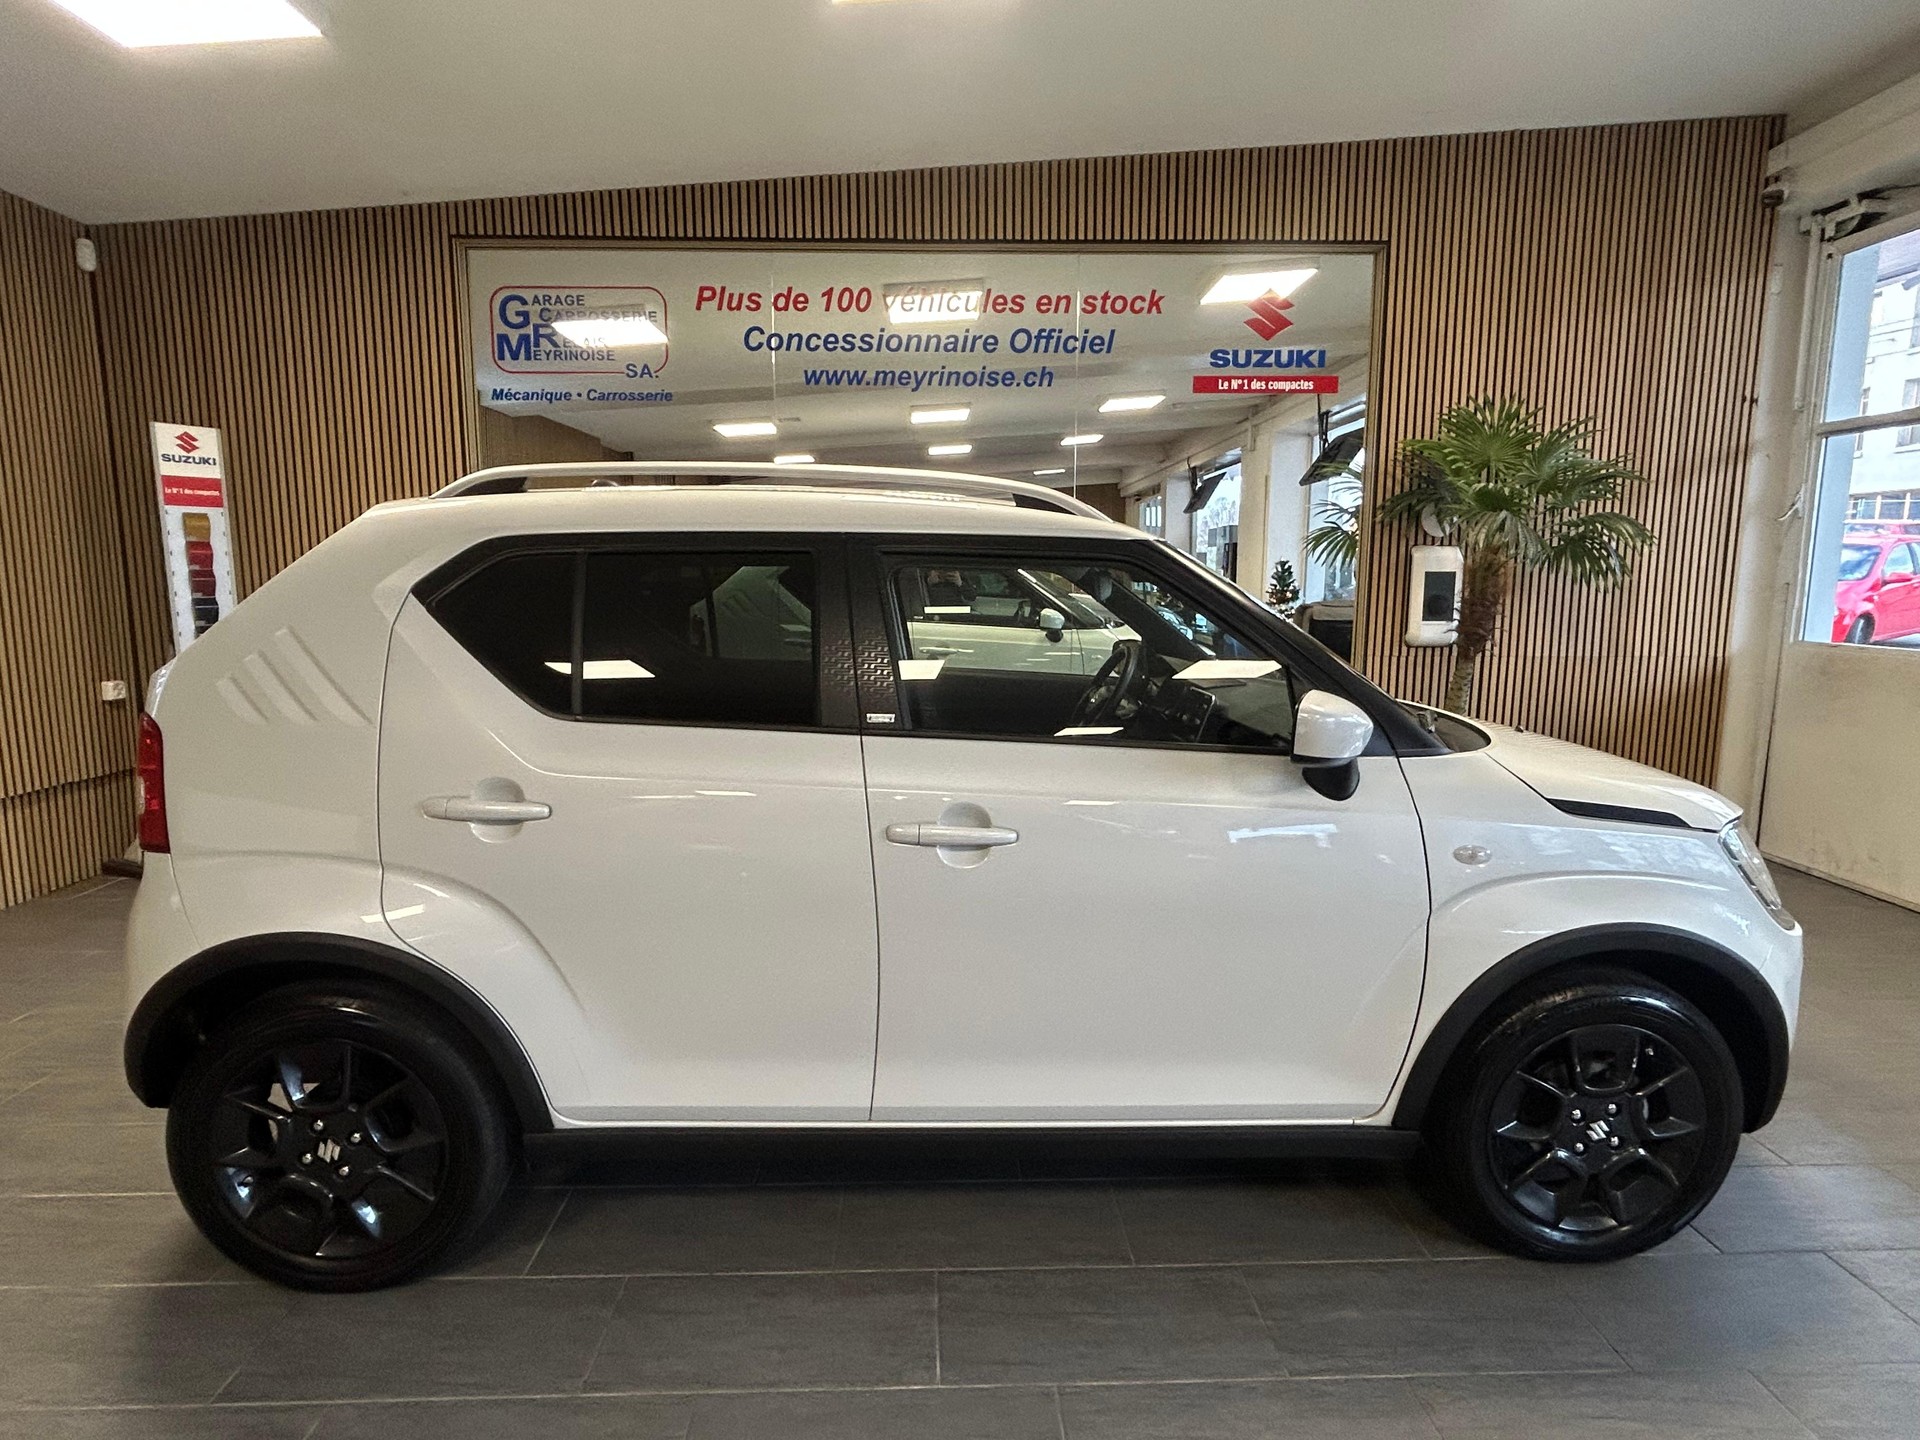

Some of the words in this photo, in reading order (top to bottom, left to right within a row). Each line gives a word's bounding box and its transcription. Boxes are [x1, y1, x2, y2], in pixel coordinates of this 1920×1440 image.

[498, 293, 586, 330] GARAGE
[695, 285, 763, 312] Plus
[773, 286, 810, 312] de
[821, 286, 872, 312] 100
[882, 286, 1026, 314] véhicules
[1035, 294, 1072, 314] en
[1081, 289, 1166, 315] stock
[496, 333, 616, 362] MEYRINOISE
[743, 325, 999, 353] Concessionnaire
[1009, 327, 1116, 354] Officiel
[1209, 348, 1326, 368] SUZUKI
[803, 366, 1054, 393] www.meyrinoise.ch
[1218, 378, 1229, 390] Le
[1250, 378, 1266, 390] des
[1268, 379, 1314, 392] compactes
[491, 388, 572, 404] Mécanique
[586, 388, 673, 402] Carrosserie
[161, 453, 217, 465] SUZUKI
